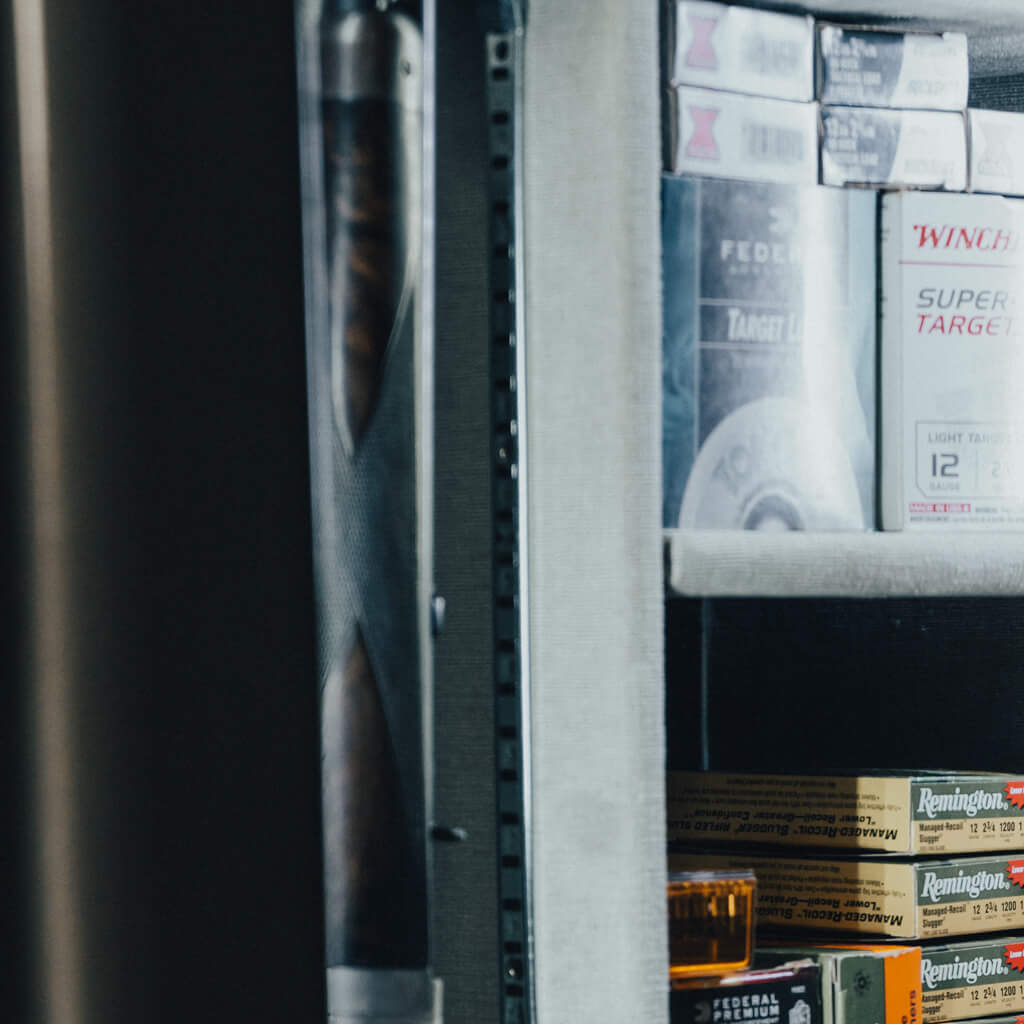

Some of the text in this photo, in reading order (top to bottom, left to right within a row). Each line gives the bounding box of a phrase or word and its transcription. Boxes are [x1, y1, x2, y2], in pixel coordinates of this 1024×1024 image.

[916, 314, 1015, 336] TARGET
[927, 432, 963, 444] LIGHT
[931, 453, 960, 478] 12
[917, 787, 1005, 818] Remington
[970, 823, 978, 833] 12
[1000, 821, 1016, 832] 1200
[920, 870, 1006, 902] Remington
[972, 904, 981, 914] 12
[1001, 901, 1017, 912] 1200
[921, 956, 1003, 989] Remington
[713, 993, 779, 1009] FEDERAL
[971, 990, 979, 1001] 12
[1000, 985, 1017, 997] 1200
[713, 1005, 779, 1022] PREMIUM
